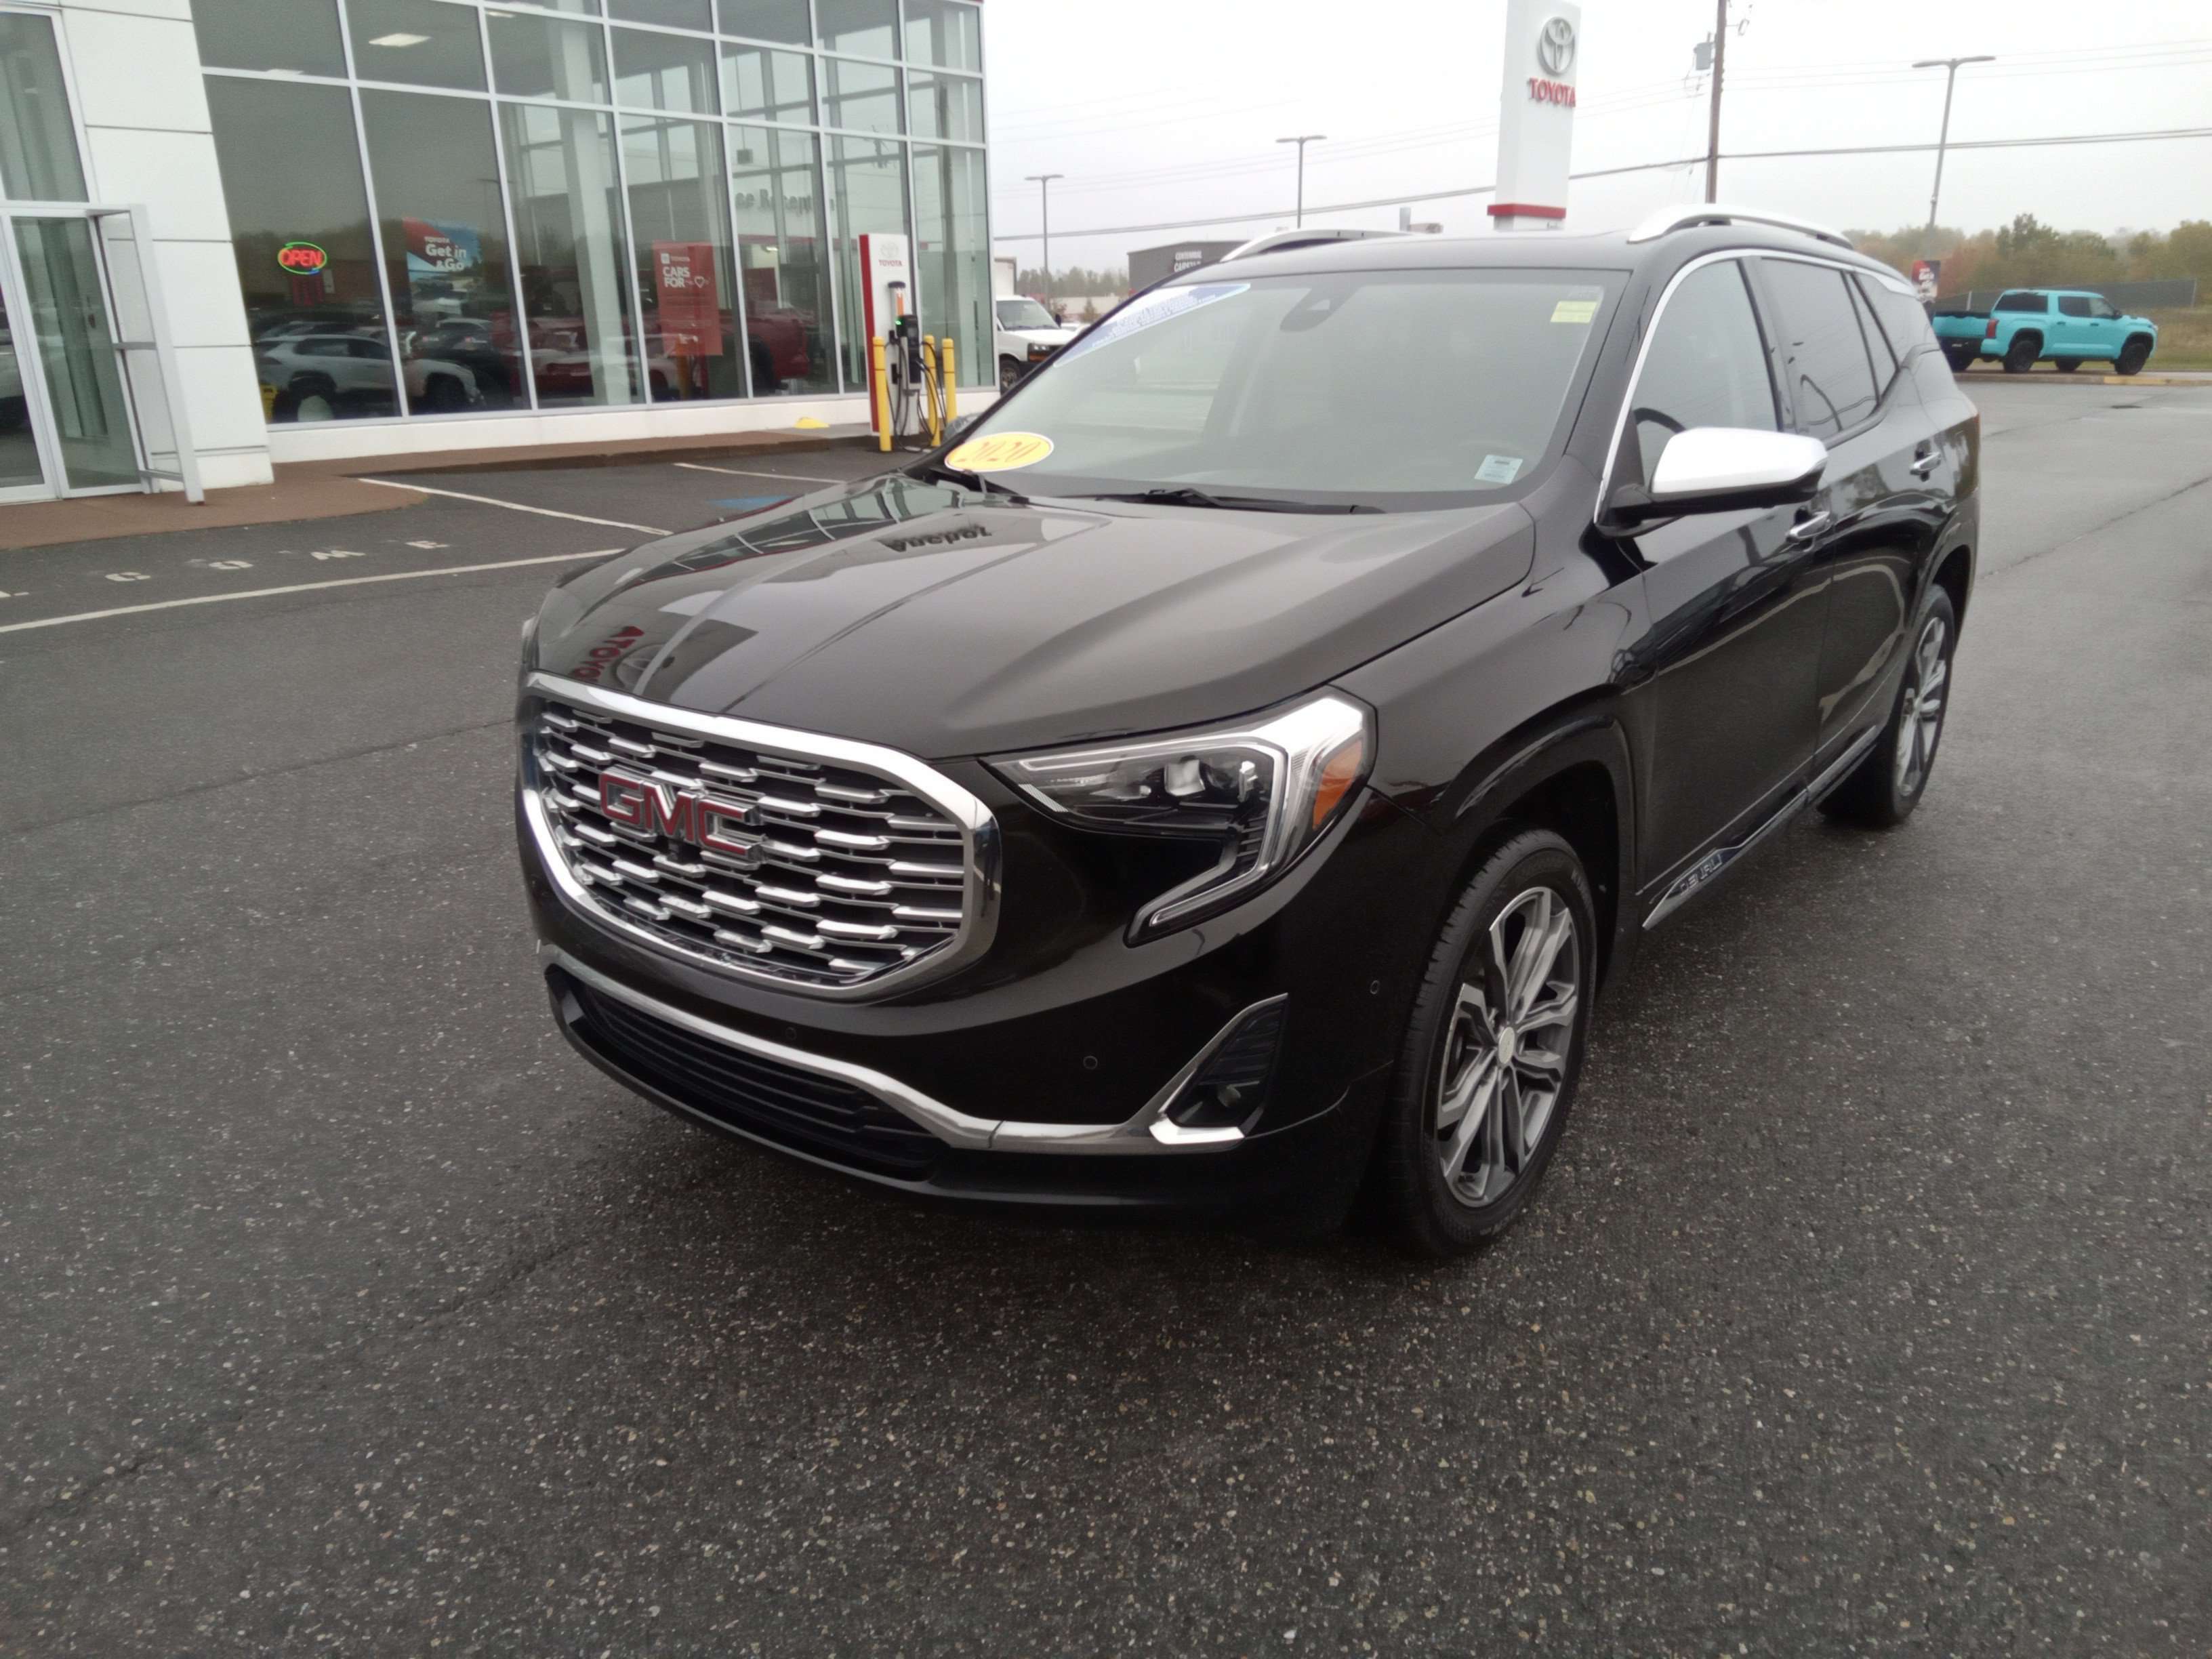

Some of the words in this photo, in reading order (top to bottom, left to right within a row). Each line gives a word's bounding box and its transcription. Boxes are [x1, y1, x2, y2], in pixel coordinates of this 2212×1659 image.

[1528, 77, 1576, 108] TOYOTA
[279, 249, 322, 267] OPEN
[426, 243, 451, 257] Get
[455, 245, 467, 258] in
[445, 258, 465, 271] Go
[663, 266, 691, 278] CARS
[664, 277, 686, 288] FOR
[599, 767, 758, 859] GMC
